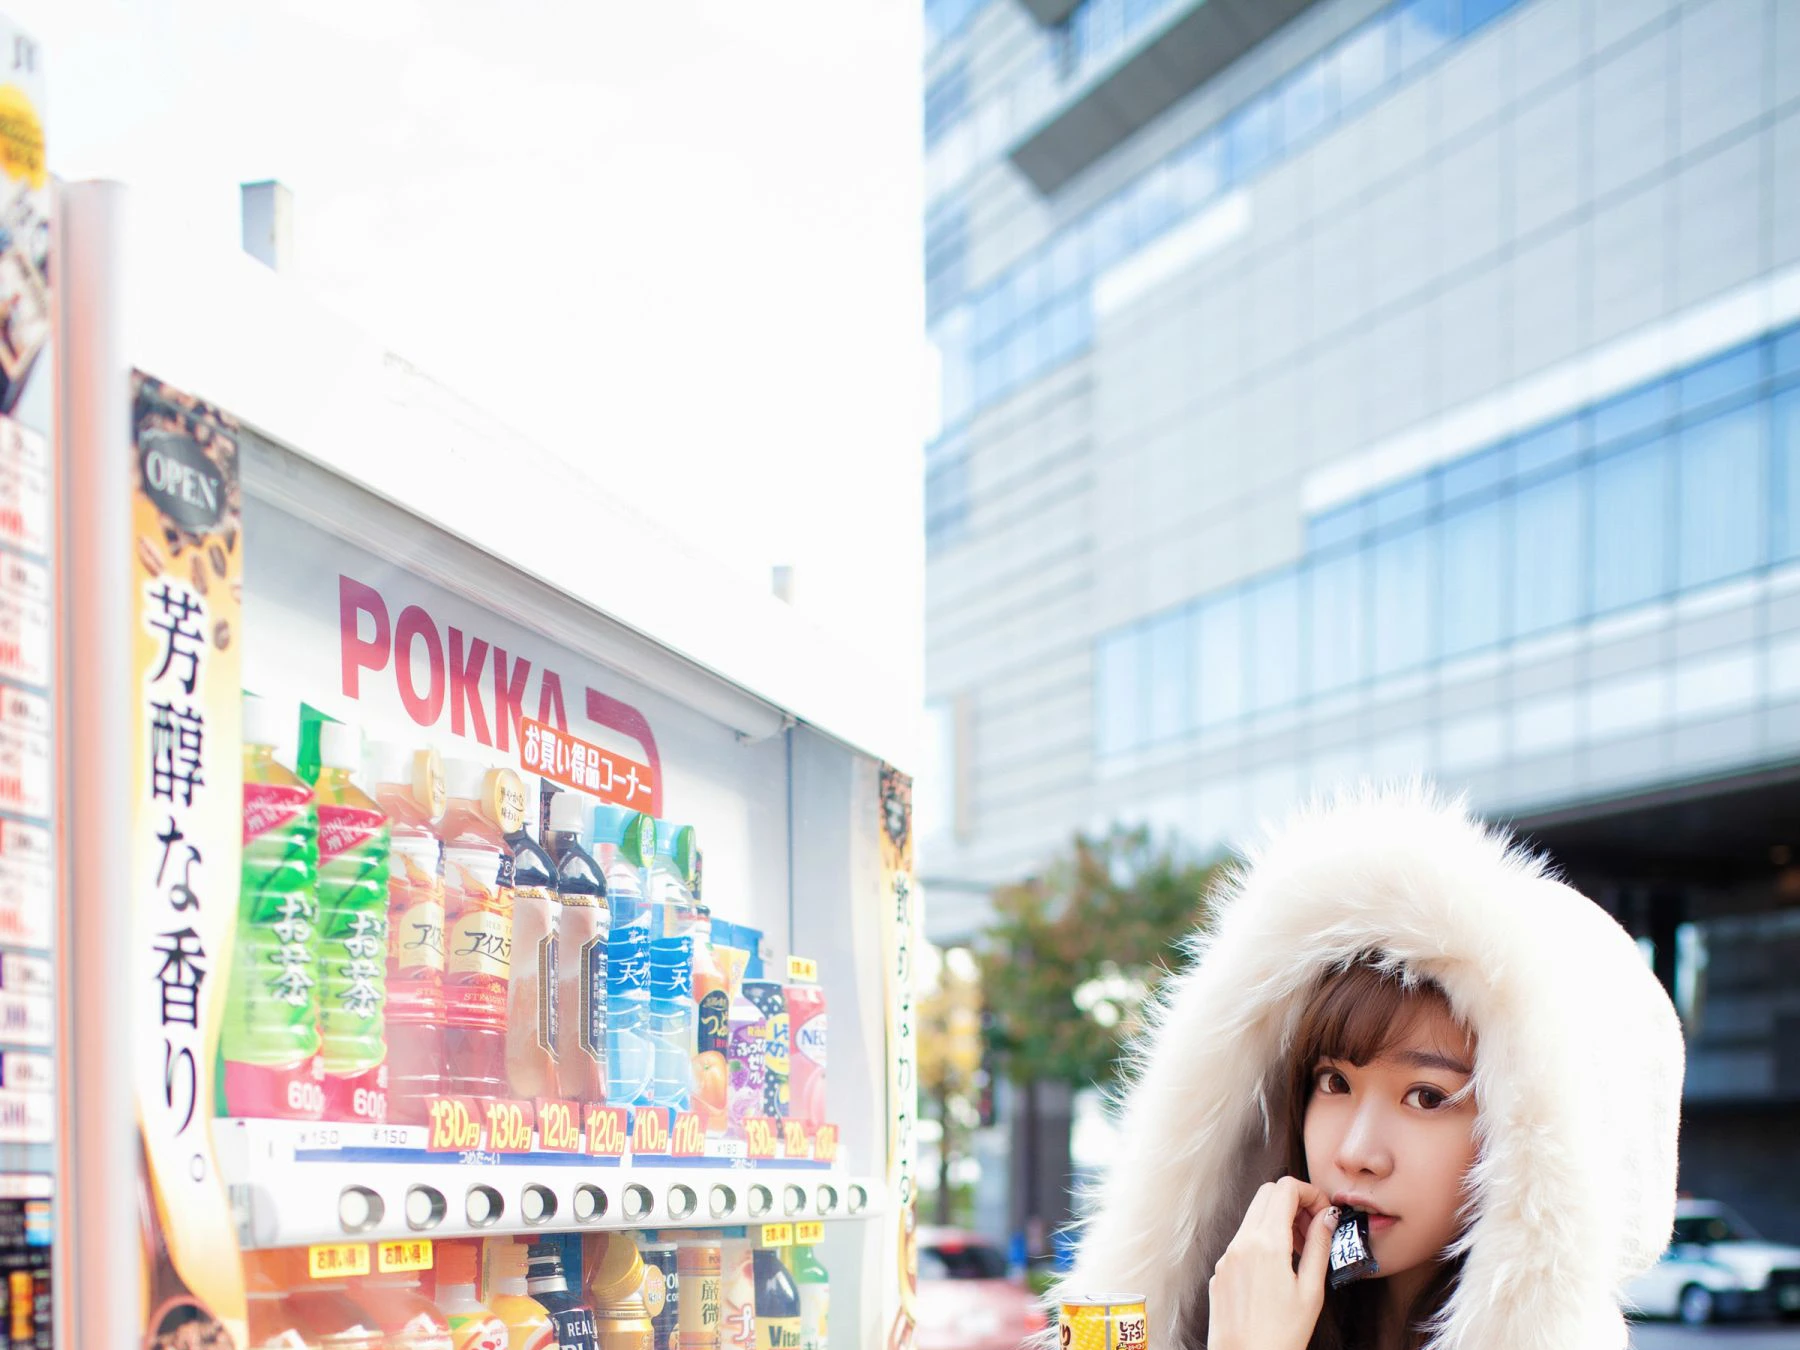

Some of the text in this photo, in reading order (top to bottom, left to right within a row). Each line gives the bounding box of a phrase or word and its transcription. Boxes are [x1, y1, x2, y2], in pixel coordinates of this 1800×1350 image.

[147, 450, 221, 511] OPEN
[338, 573, 569, 754] POKKA
[524, 722, 653, 802] お買い得品コーナー
[147, 583, 206, 1183] 芳醇な香り。
[431, 1100, 480, 1148] 130円
[487, 1103, 532, 1149] 130円
[540, 1103, 579, 1149] 120円
[586, 1110, 624, 1153] 120円
[631, 1110, 668, 1150] 110円
